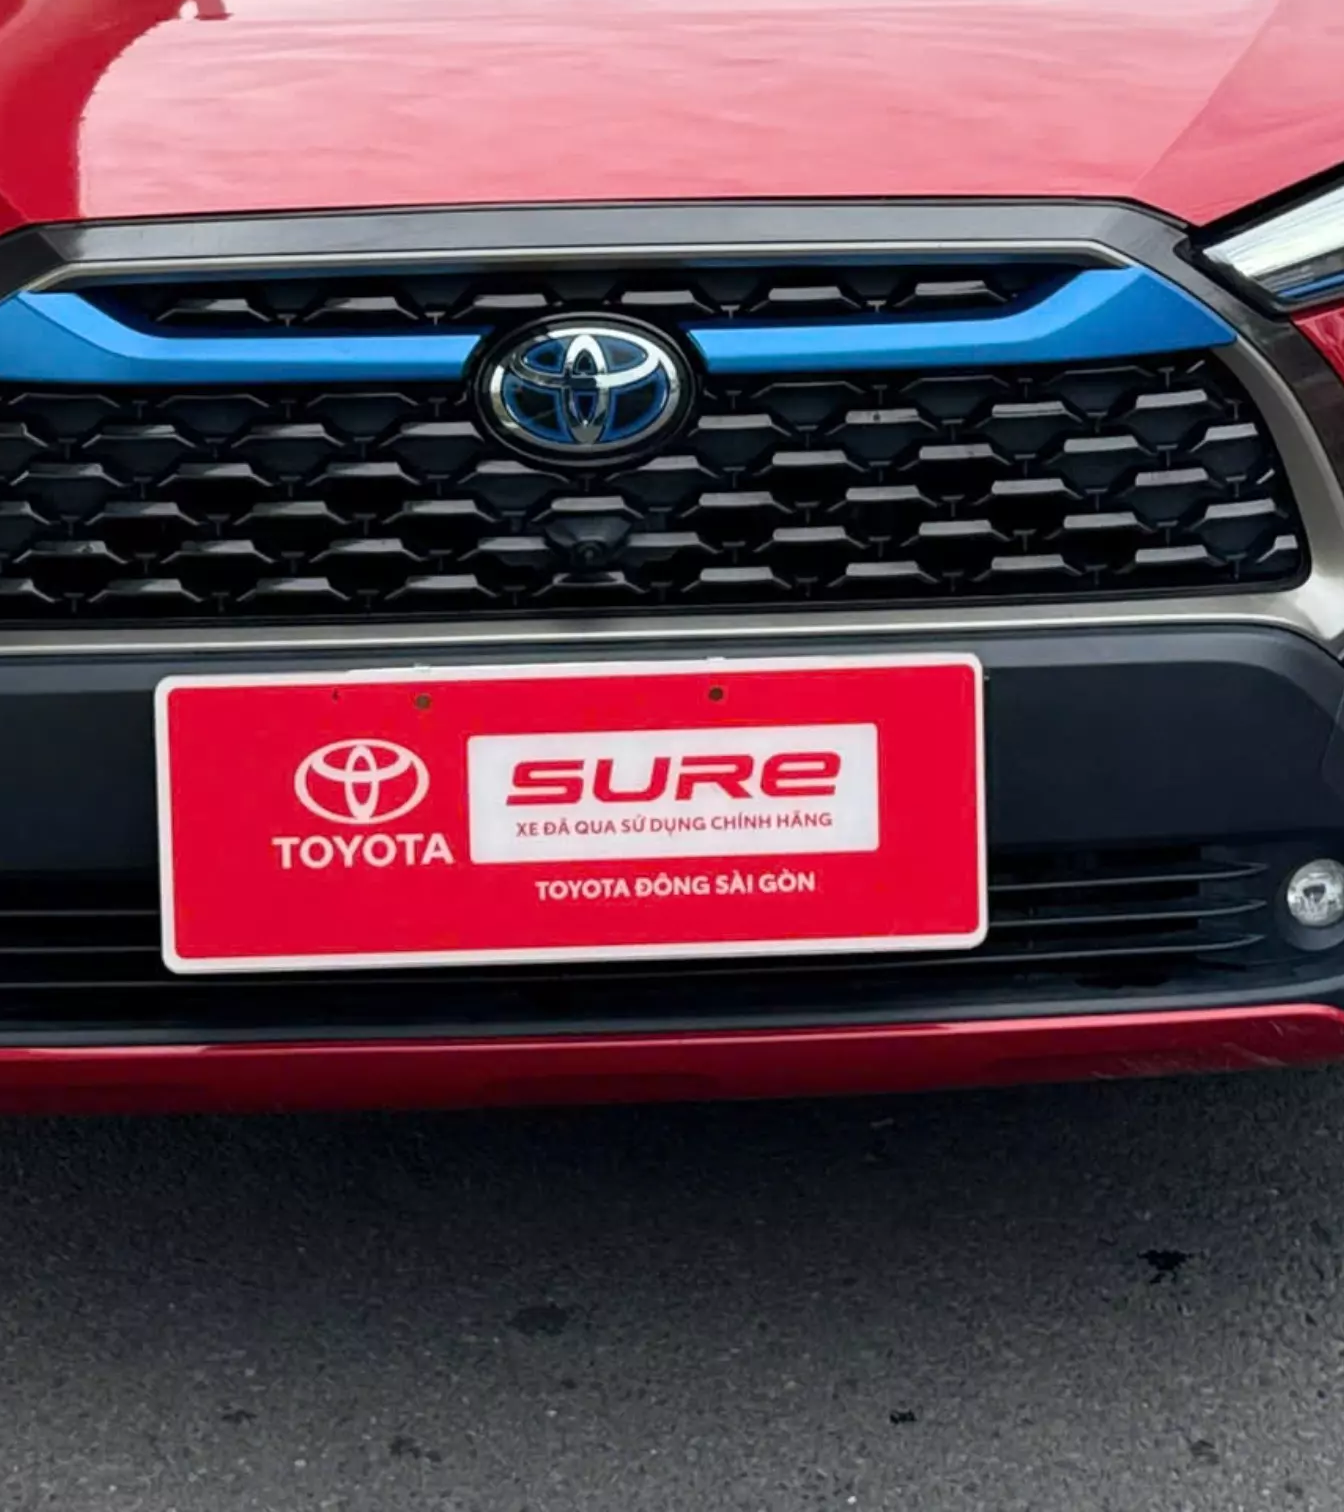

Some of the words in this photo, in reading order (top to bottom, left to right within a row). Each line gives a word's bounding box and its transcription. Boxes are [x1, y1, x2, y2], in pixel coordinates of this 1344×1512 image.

[516, 821, 539, 837] XE
[543, 817, 570, 836] ĐÃ
[574, 819, 617, 835] QUA
[621, 813, 646, 833] SỬ
[649, 816, 706, 837] DỤNG
[711, 811, 772, 831] CHÍNH
[776, 810, 833, 829] HÃNG
[271, 832, 455, 870] TOYOTA
[534, 877, 631, 901] TOYOTA
[634, 871, 711, 898] ĐÔNG
[715, 868, 754, 895] SÀI
[758, 867, 816, 894] GÒN
